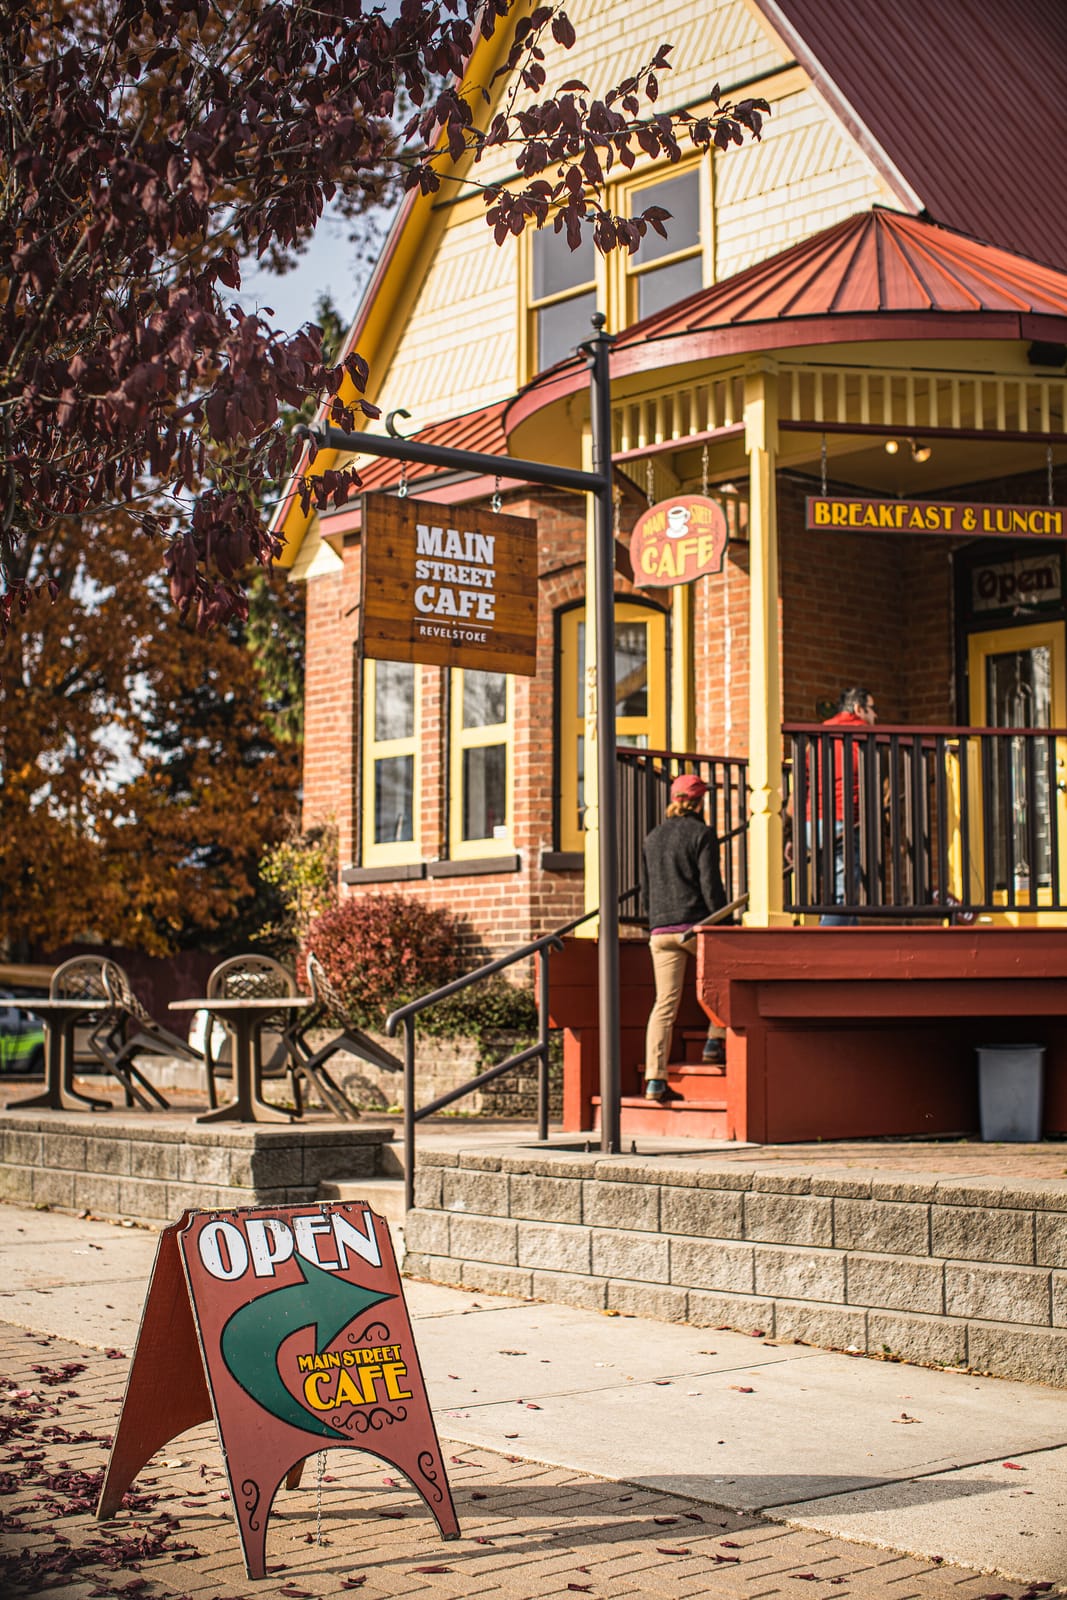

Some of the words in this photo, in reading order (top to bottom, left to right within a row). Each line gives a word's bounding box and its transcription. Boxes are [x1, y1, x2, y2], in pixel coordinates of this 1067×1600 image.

[814, 502, 955, 530] BREAKFAST
[962, 508, 977, 531] &
[983, 509, 1062, 534] LUNCH
[416, 524, 495, 564] MAIN
[415, 559, 496, 588] STREET
[978, 568, 1055, 604] Open
[414, 584, 496, 621] CAFE
[419, 625, 487, 643] REVELSTOKE
[198, 1211, 382, 1281] OPEN
[298, 1353, 341, 1372] MAIN
[342, 1345, 401, 1367] STREET
[303, 1362, 413, 1412] CAFE
